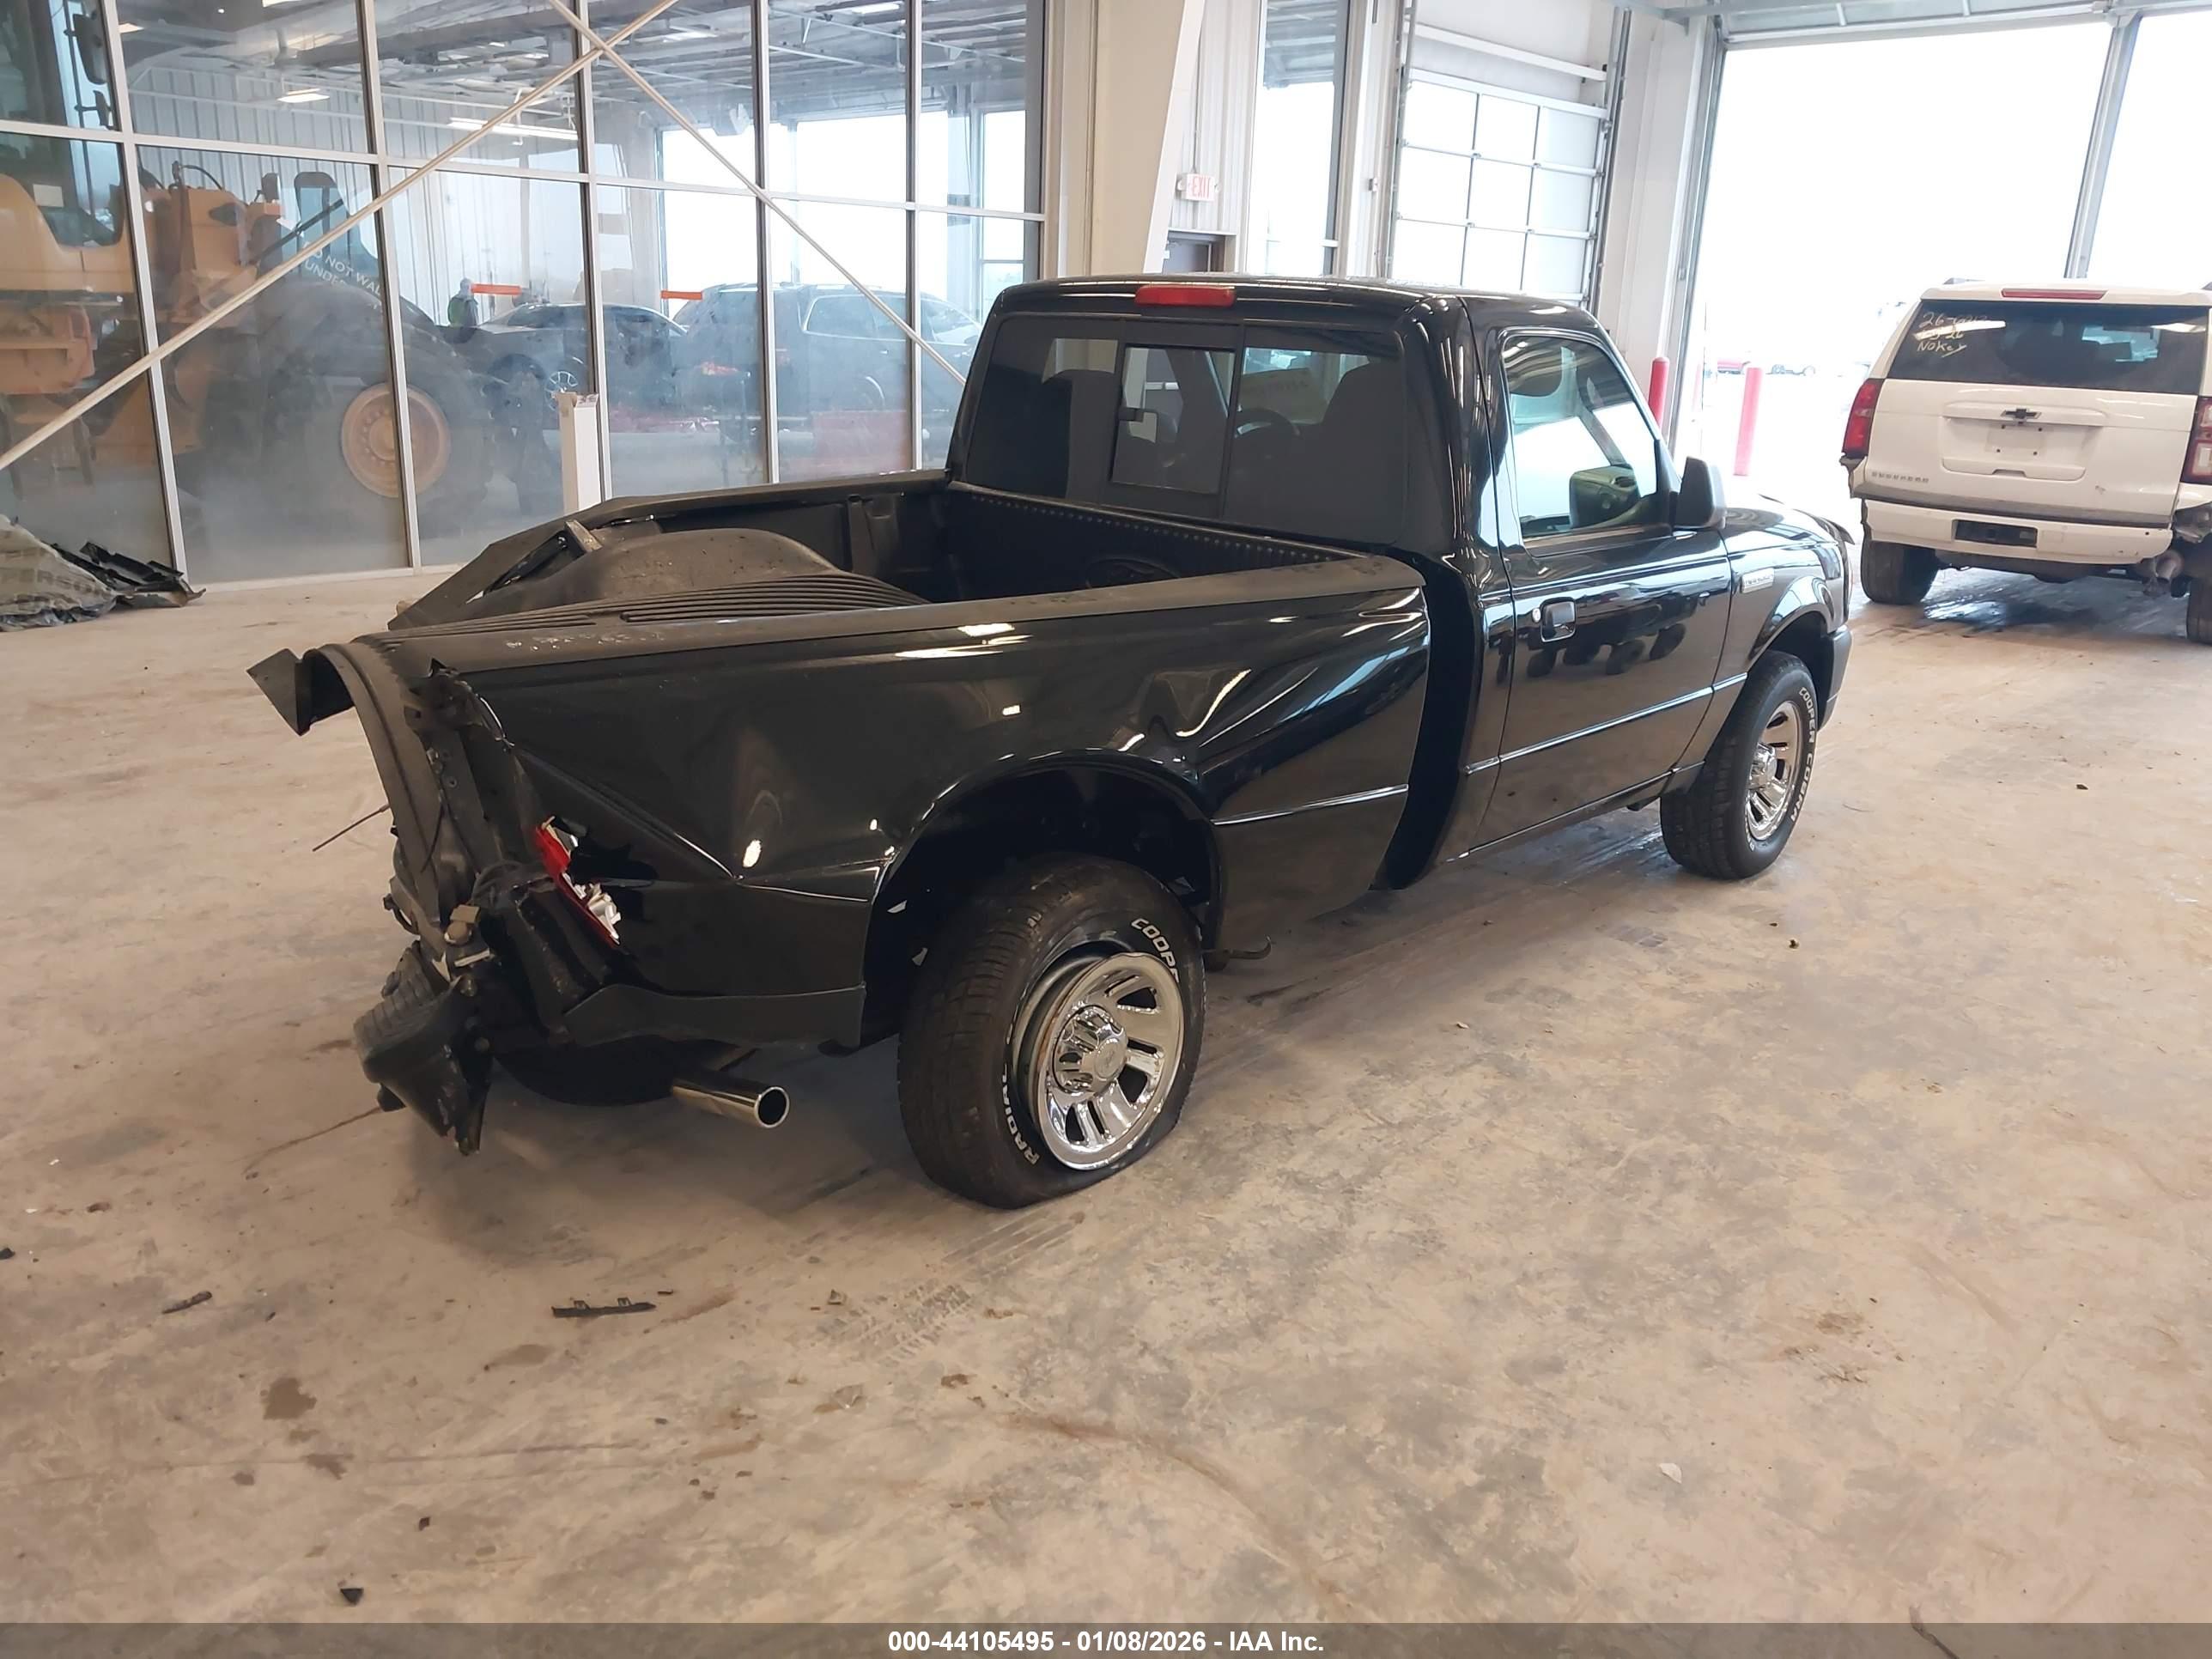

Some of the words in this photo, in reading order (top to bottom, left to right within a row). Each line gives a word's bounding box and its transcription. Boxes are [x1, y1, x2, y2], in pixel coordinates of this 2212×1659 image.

[1193, 175, 1211, 199] EXIT
[325, 256, 354, 276] NOT
[1799, 687, 1815, 744] COOPER
